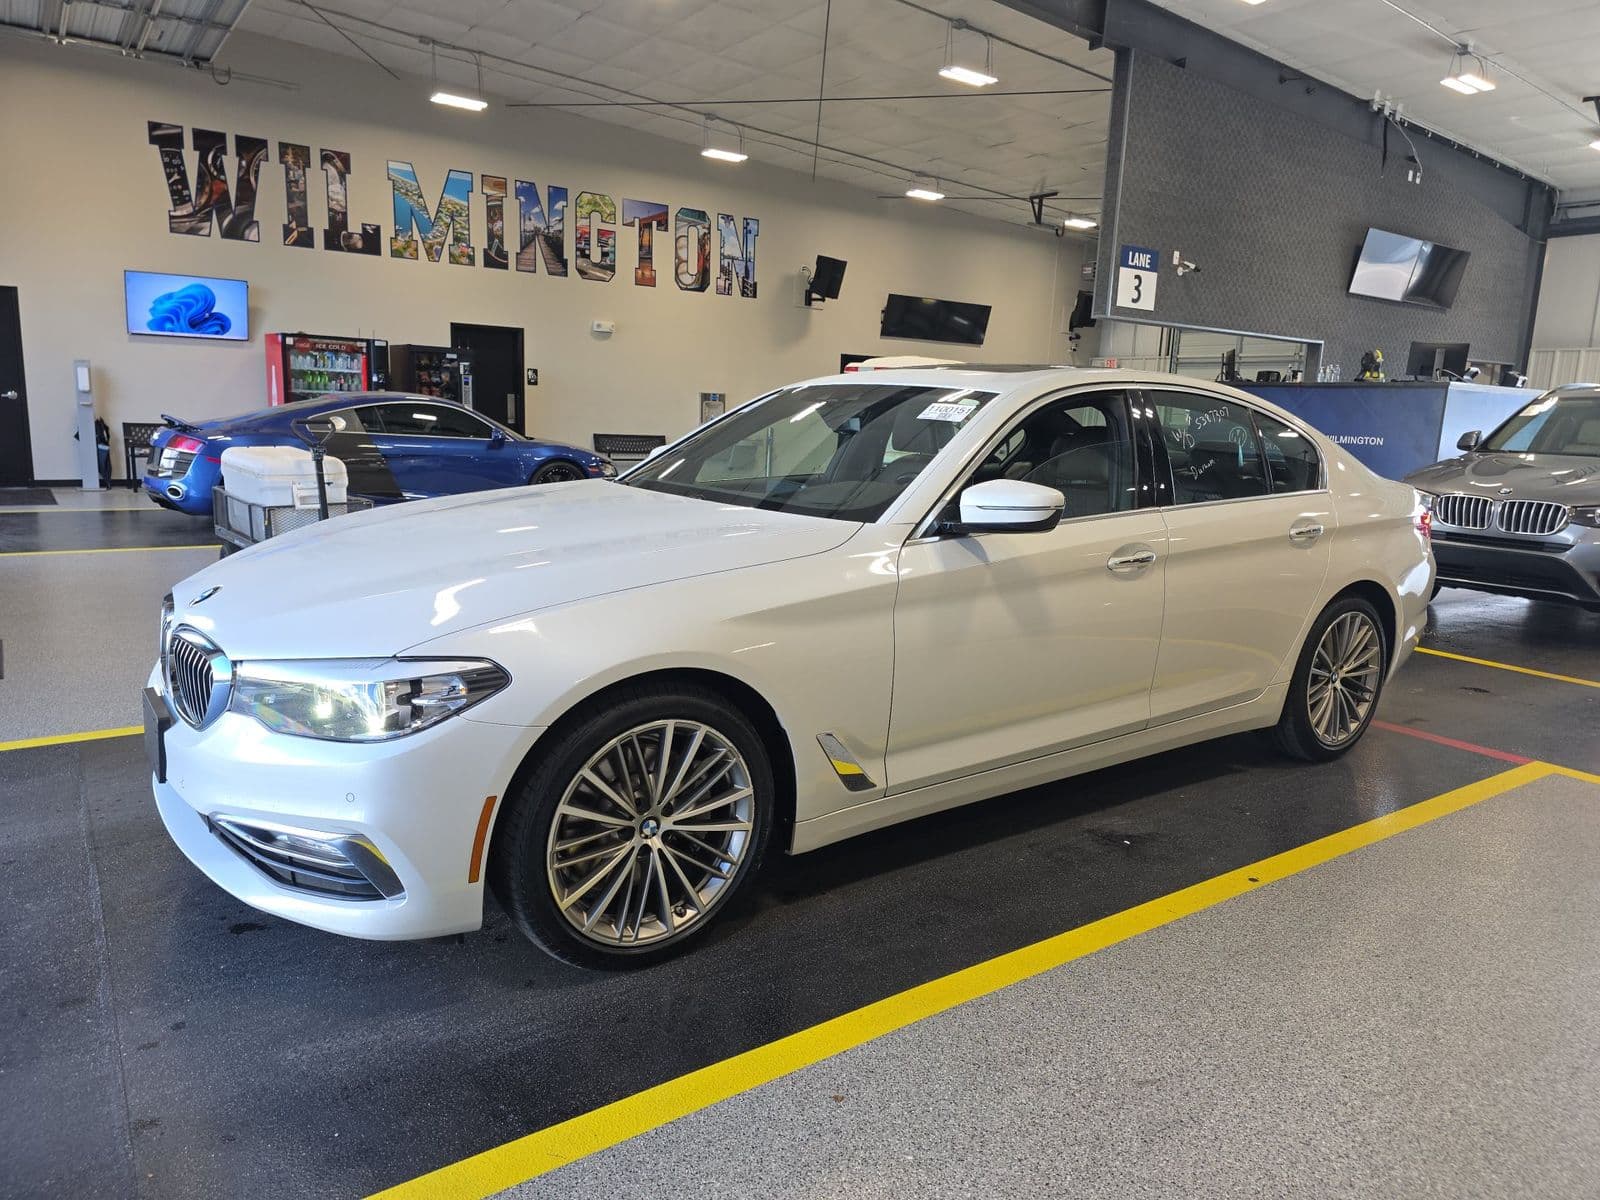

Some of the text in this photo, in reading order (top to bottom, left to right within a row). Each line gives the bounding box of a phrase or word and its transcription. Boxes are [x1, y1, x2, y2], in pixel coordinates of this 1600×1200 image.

[148, 120, 760, 299] WILMINGTON
[1128, 251, 1151, 269] LANE
[1131, 274, 1143, 304] 3
